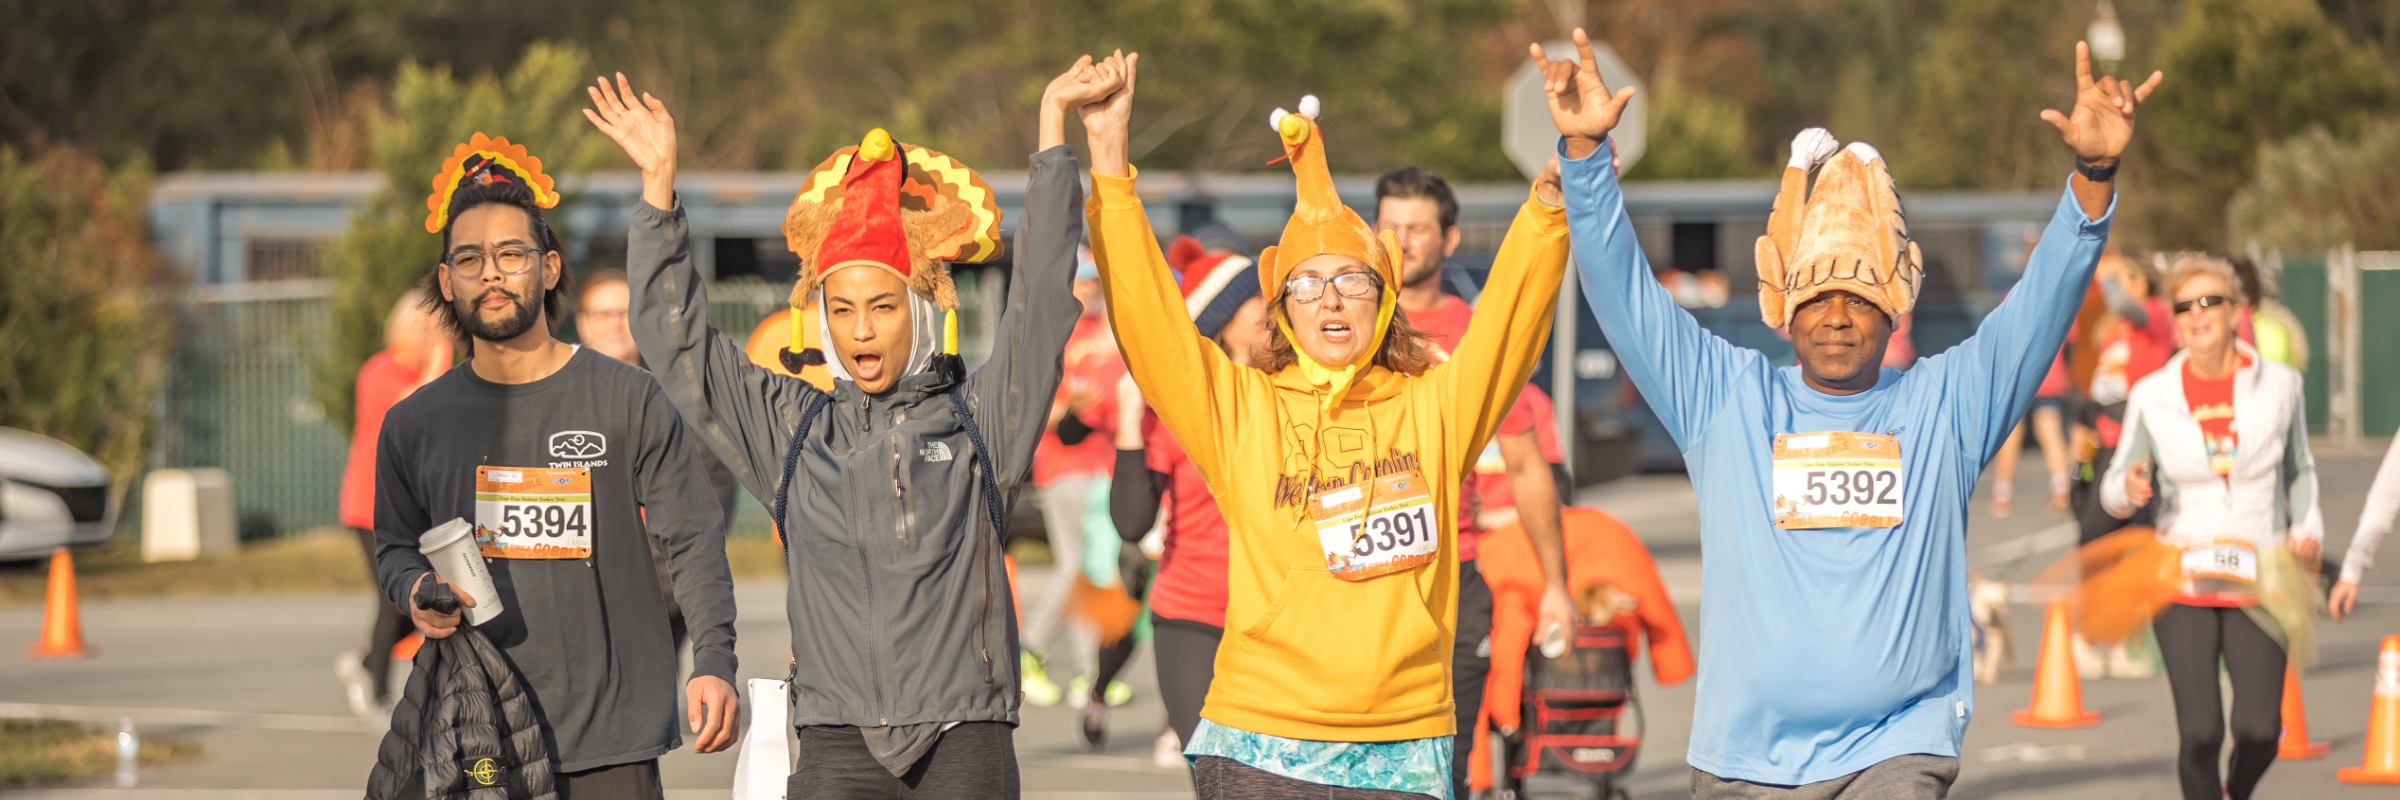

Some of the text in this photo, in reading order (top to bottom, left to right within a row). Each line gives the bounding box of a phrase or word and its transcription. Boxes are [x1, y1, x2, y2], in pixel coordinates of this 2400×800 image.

[1812, 441, 1850, 459] GOBBLE
[548, 460, 608, 469] TWIN ISLANDS
[1349, 447, 1418, 485] Carolin
[508, 477, 543, 493] GOBBLE
[1807, 471, 1897, 505] 5392
[1349, 487, 1383, 512] GOBLE
[503, 505, 587, 538] 5394
[1841, 510, 1894, 527] GOBBLE
[1350, 507, 1429, 557] 5391
[533, 543, 586, 558] GOBBLE
